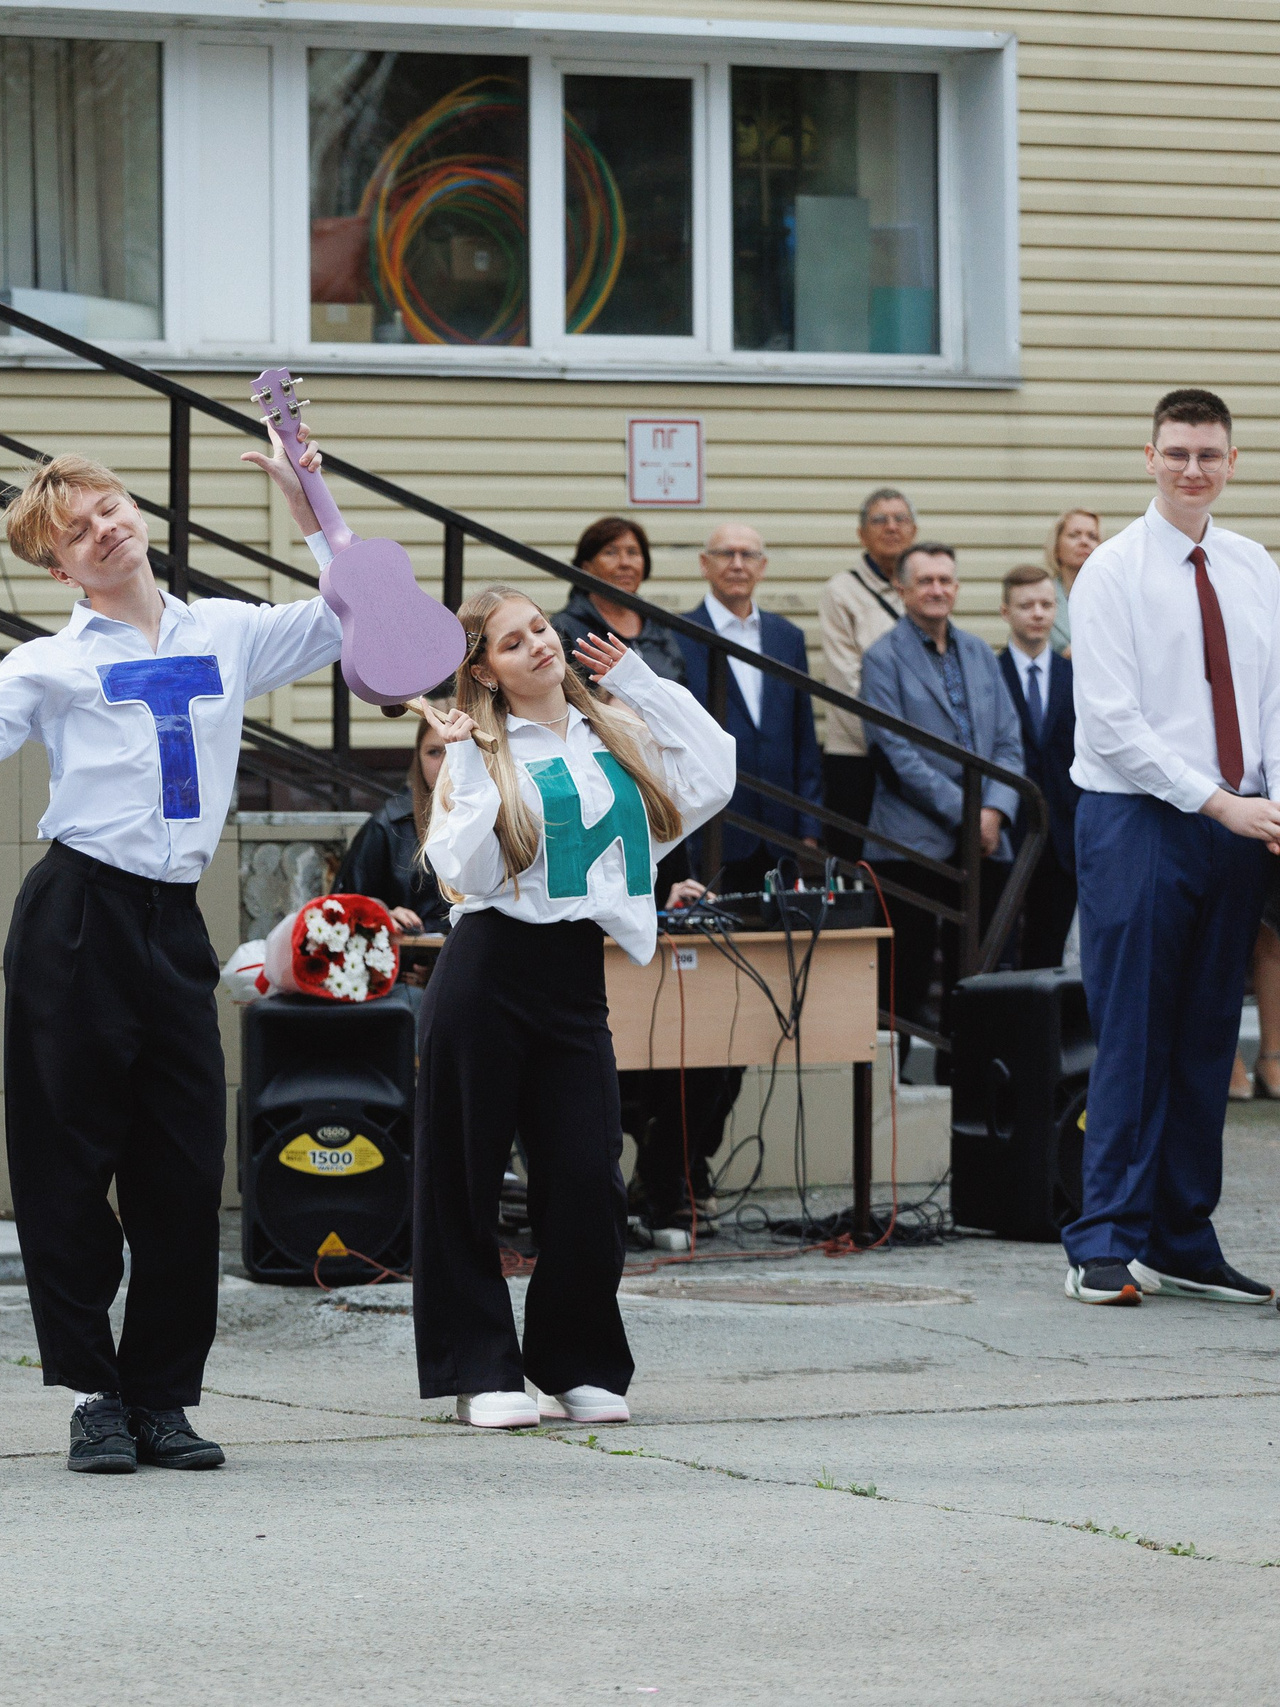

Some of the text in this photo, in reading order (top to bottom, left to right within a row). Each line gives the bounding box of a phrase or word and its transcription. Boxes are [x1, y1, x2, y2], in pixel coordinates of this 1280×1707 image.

[652, 428, 679, 449] ПГ
[524, 750, 653, 899] И
[310, 1151, 353, 1165] 1500
